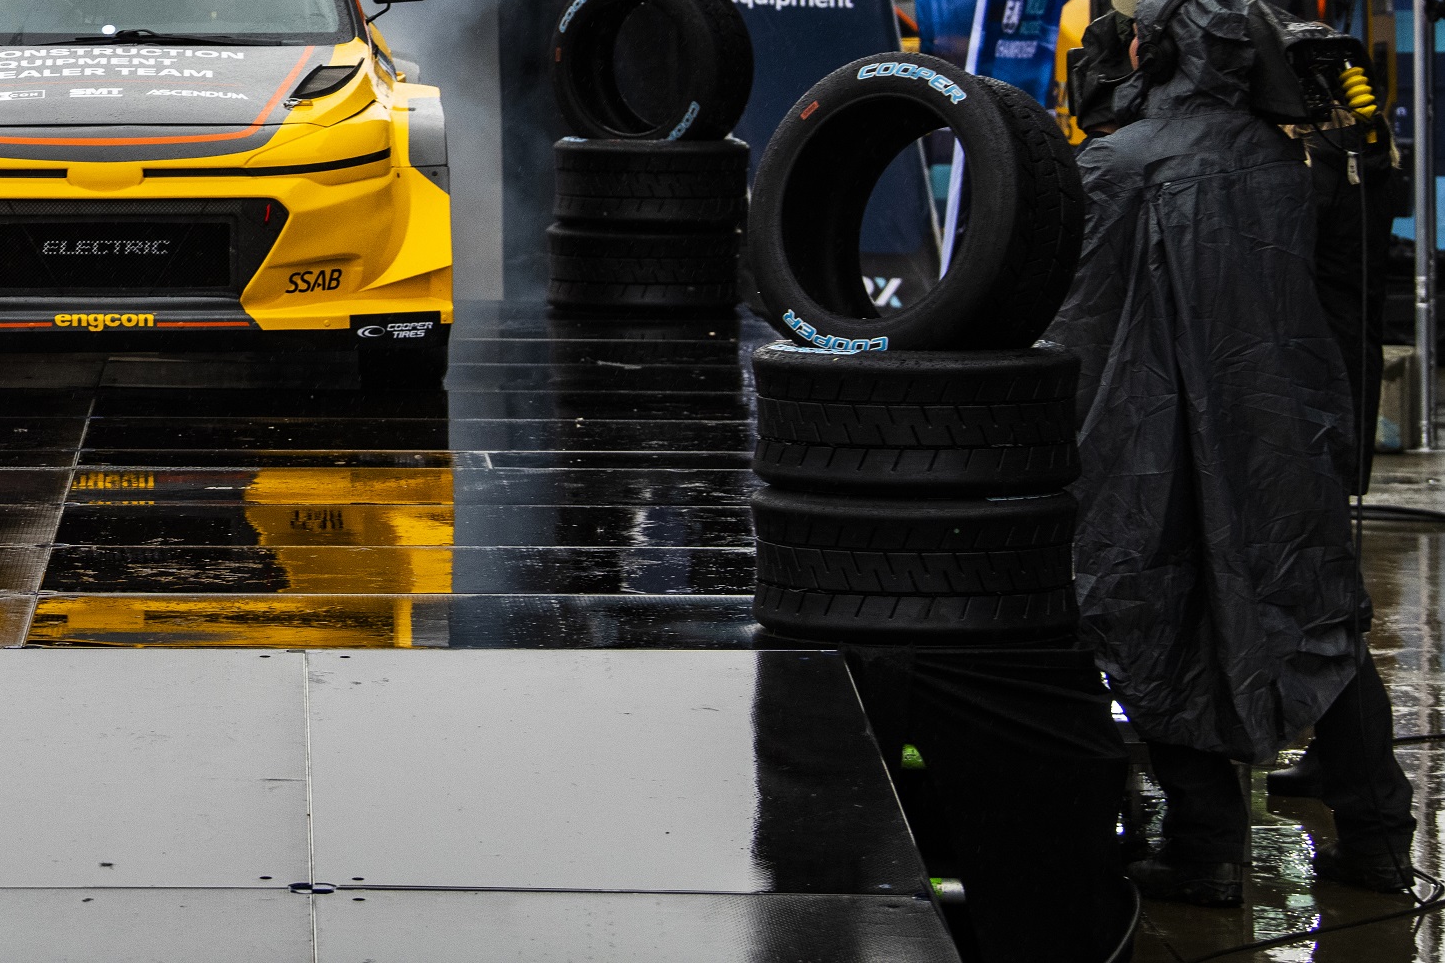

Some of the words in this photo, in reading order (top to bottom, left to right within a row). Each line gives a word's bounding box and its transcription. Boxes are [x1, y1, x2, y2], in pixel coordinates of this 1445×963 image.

[115, 67, 213, 78] TEAM
[857, 61, 967, 104] COOPER
[69, 87, 123, 96] SMT
[145, 88, 249, 100] ASCENDUM
[42, 240, 171, 254] ELECTRIC
[285, 268, 343, 294] SSAB
[54, 313, 155, 332] engcon
[387, 322, 434, 331] COOPER
[392, 330, 426, 339] TIRES
[782, 308, 889, 351] COOPER
